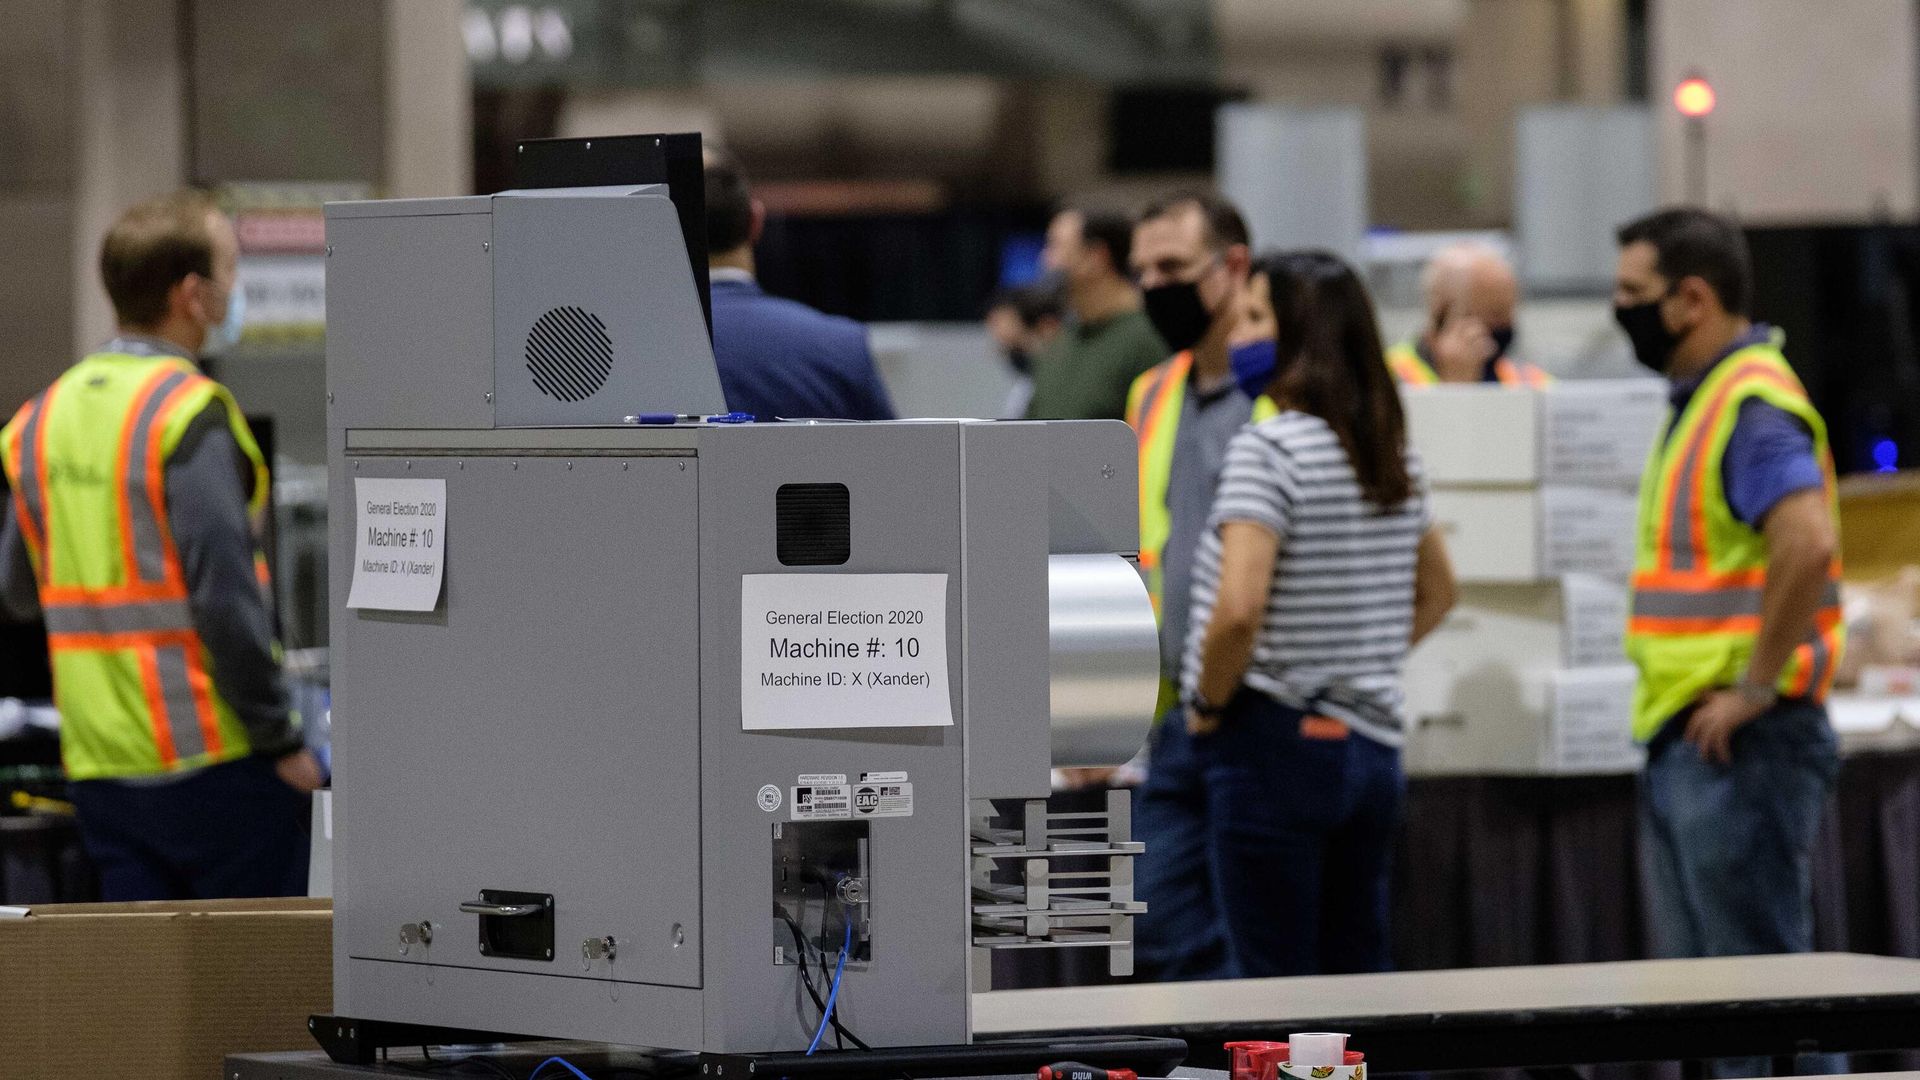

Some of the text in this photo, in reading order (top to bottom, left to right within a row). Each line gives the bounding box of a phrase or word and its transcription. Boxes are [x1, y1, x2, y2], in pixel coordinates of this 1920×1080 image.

[367, 501, 437, 516] General Election 2020
[368, 527, 434, 548] Machine #: 10
[362, 559, 435, 577] Machine ID: X (Xander)
[765, 610, 924, 625] General Election 2020
[770, 637, 920, 658] Machine #: 10
[761, 671, 930, 689] Machine ID: X (Xander)
[856, 795, 878, 806] EAC
